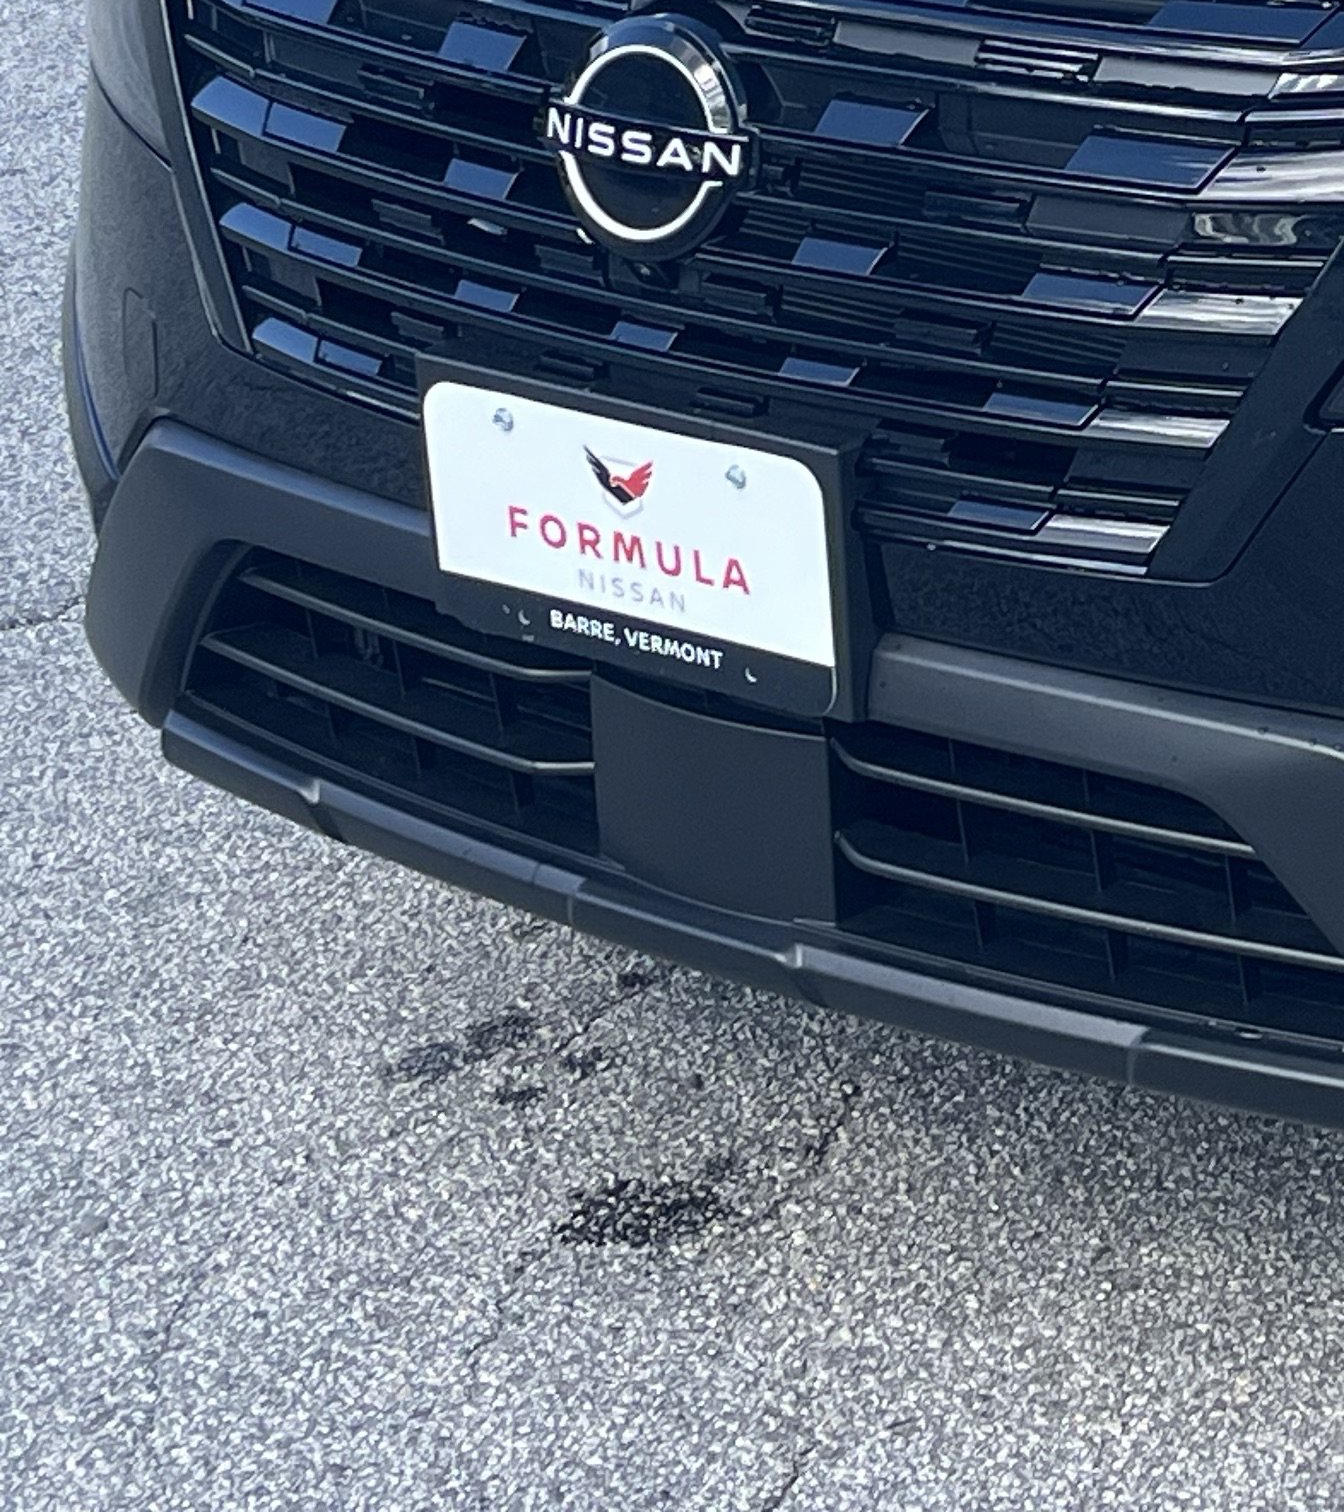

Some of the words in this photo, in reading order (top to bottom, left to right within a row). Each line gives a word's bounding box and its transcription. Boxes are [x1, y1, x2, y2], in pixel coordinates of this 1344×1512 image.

[546, 106, 743, 179] NISSAN
[507, 504, 751, 596] FORMULA
[577, 568, 688, 613] NISSAN
[549, 608, 621, 648] BARRE,
[623, 627, 724, 671] VERMONT
